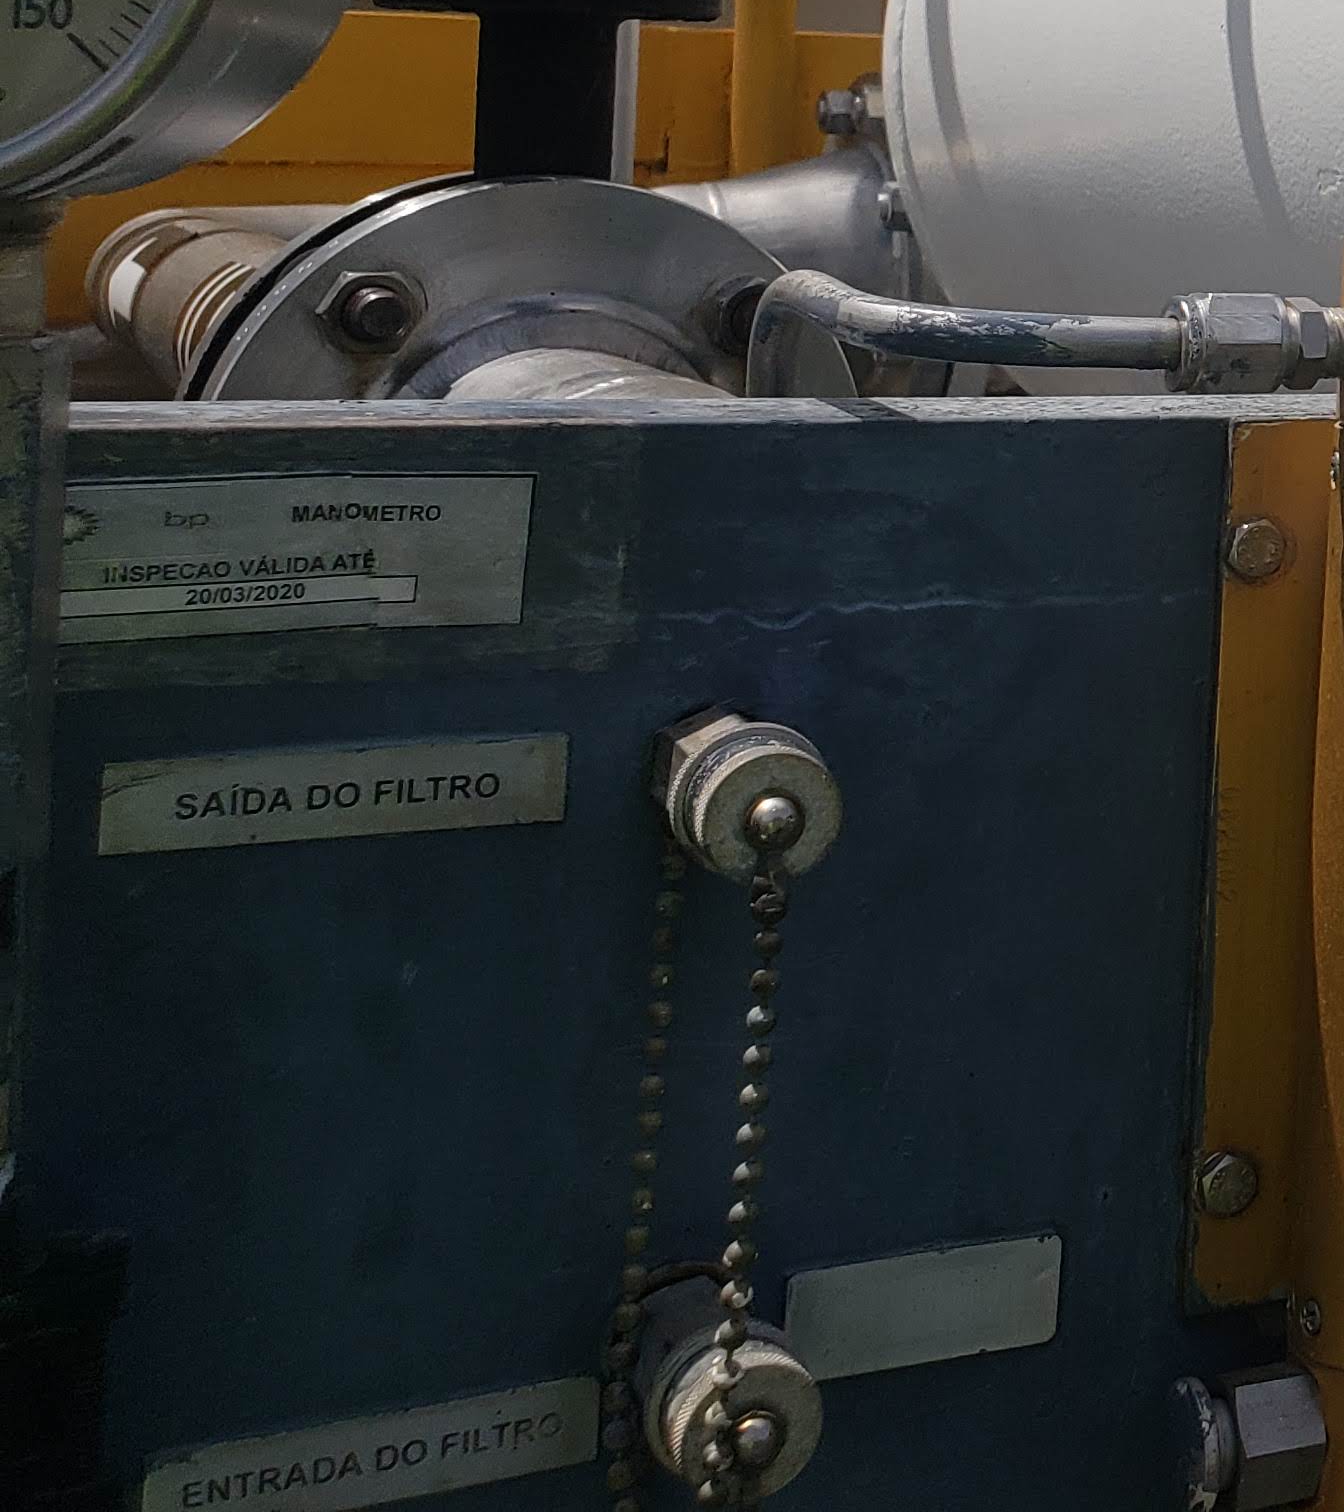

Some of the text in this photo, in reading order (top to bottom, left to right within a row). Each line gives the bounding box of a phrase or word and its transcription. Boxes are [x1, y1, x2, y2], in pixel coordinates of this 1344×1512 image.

[291, 502, 442, 523] MANOMETRO
[239, 554, 325, 577] VÁLIDA
[333, 548, 376, 571] ATÉ
[184, 583, 306, 606] 20/03/2020
[174, 772, 500, 820] SAÍDA DO FILTRO
[182, 1410, 563, 1510] ENTRADA DO FILTRO
